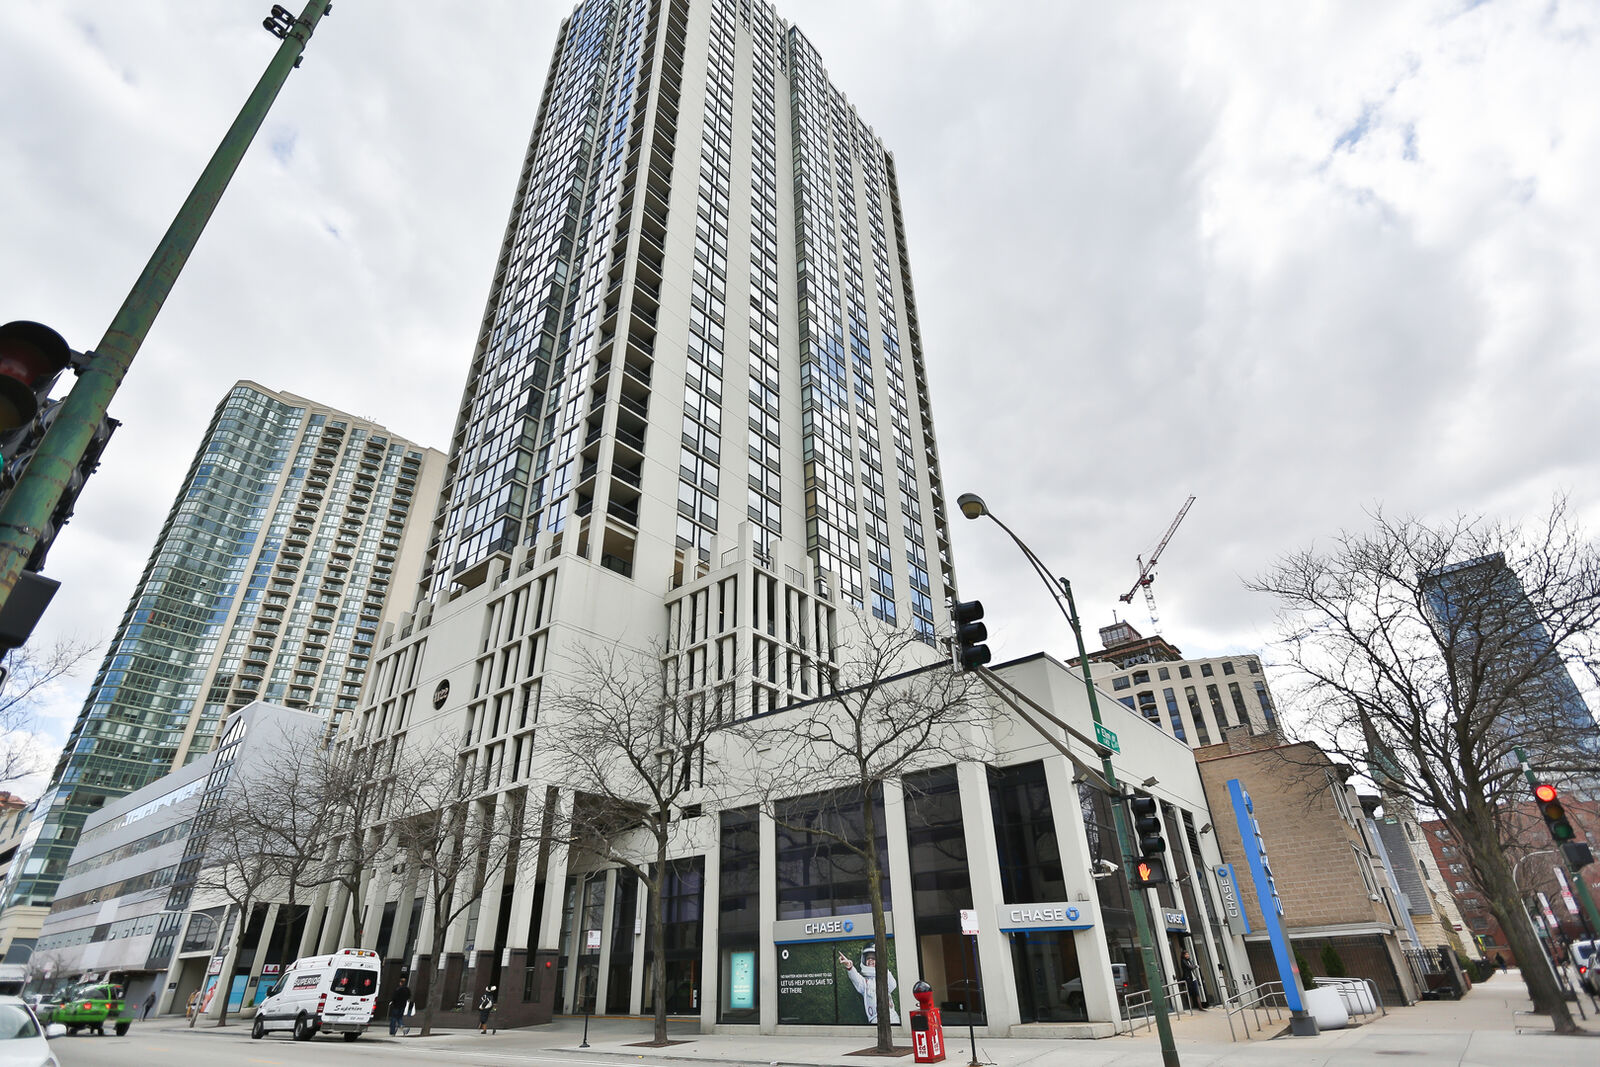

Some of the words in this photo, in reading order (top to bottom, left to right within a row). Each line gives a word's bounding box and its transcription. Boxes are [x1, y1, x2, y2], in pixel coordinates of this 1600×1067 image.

[1221, 879, 1238, 918] CHASE
[1010, 908, 1064, 923] CHASE
[1166, 912, 1183, 924] CHASE
[805, 920, 842, 934] CHASE
